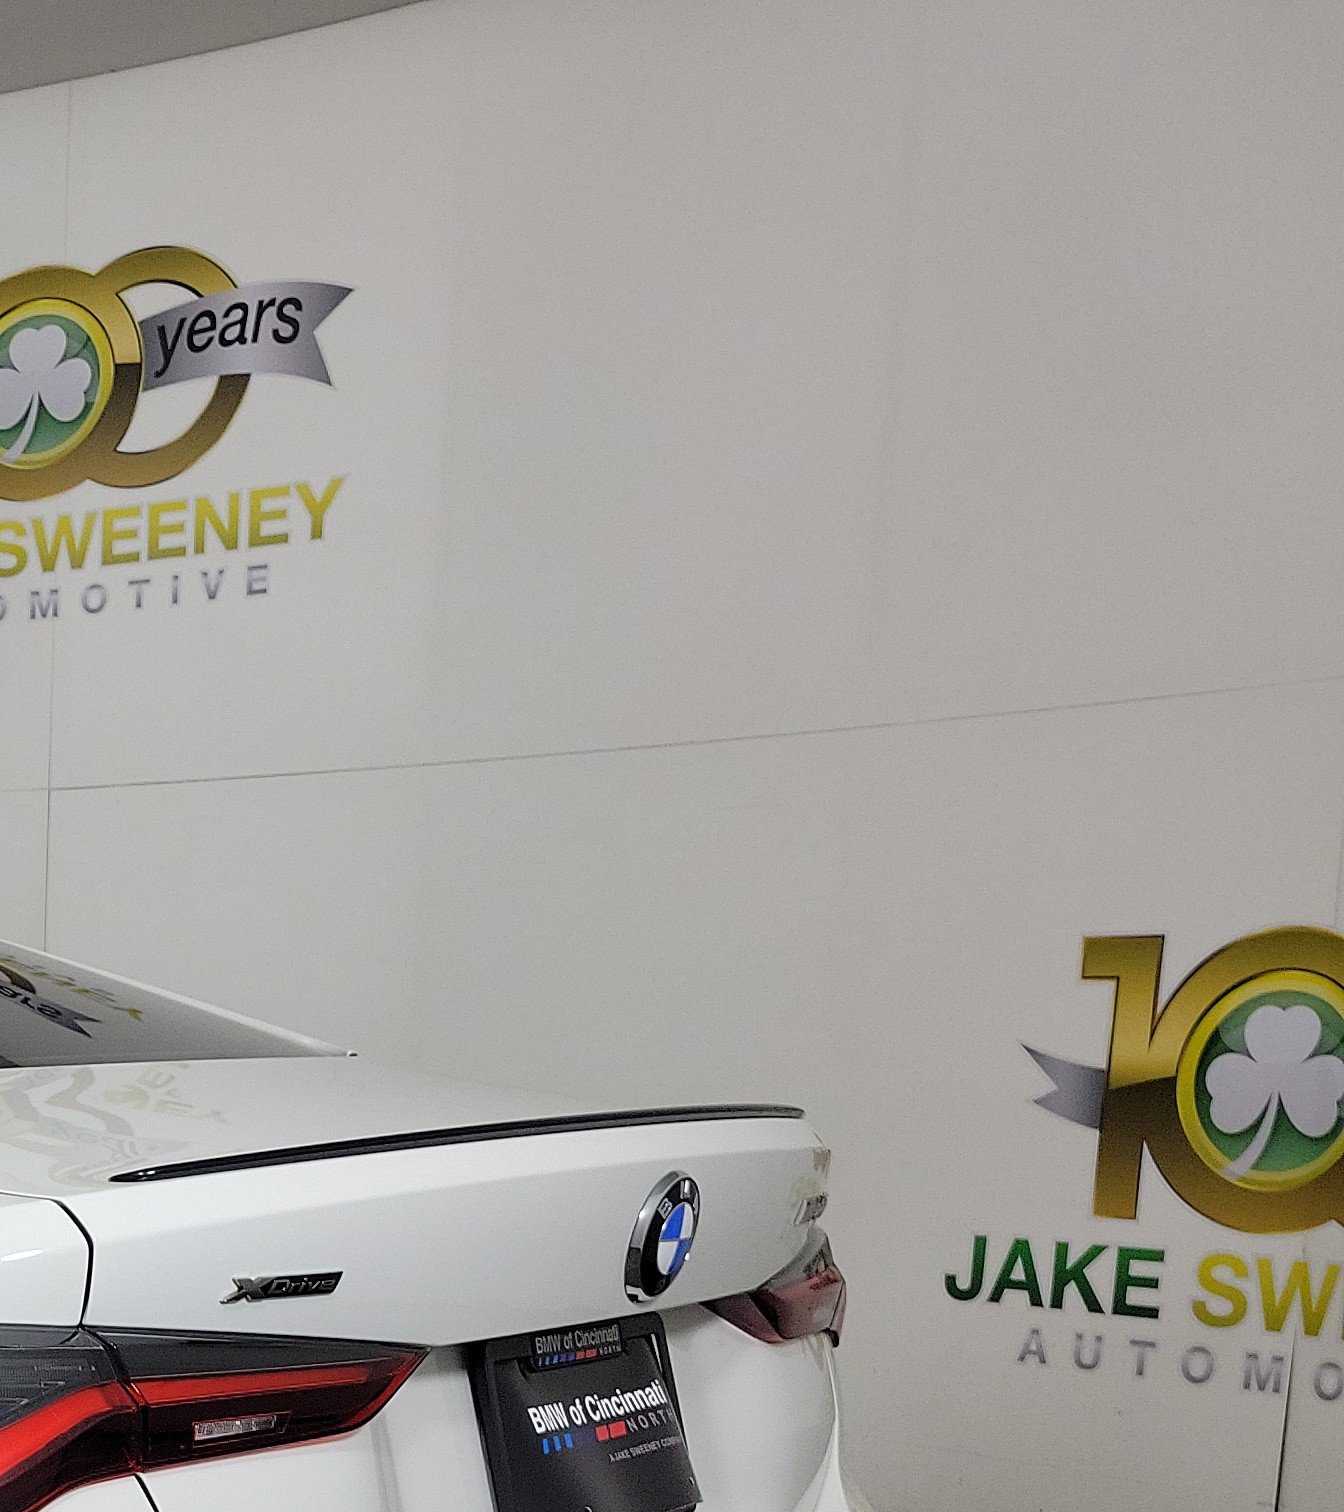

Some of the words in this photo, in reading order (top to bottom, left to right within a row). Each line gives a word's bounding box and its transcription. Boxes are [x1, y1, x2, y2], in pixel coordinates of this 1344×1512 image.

[153, 293, 304, 378] years
[943, 1235, 1166, 1320] JAKE
[1191, 1252, 1344, 1341] SW
[535, 1333, 561, 1354] BMW
[563, 1331, 573, 1350] of
[574, 1324, 619, 1348] Cincinnati
[1017, 1328, 1344, 1401] AUTOMO
[527, 1401, 570, 1434] BMW
[569, 1398, 587, 1426] of
[584, 1378, 667, 1423] Cincinnati
